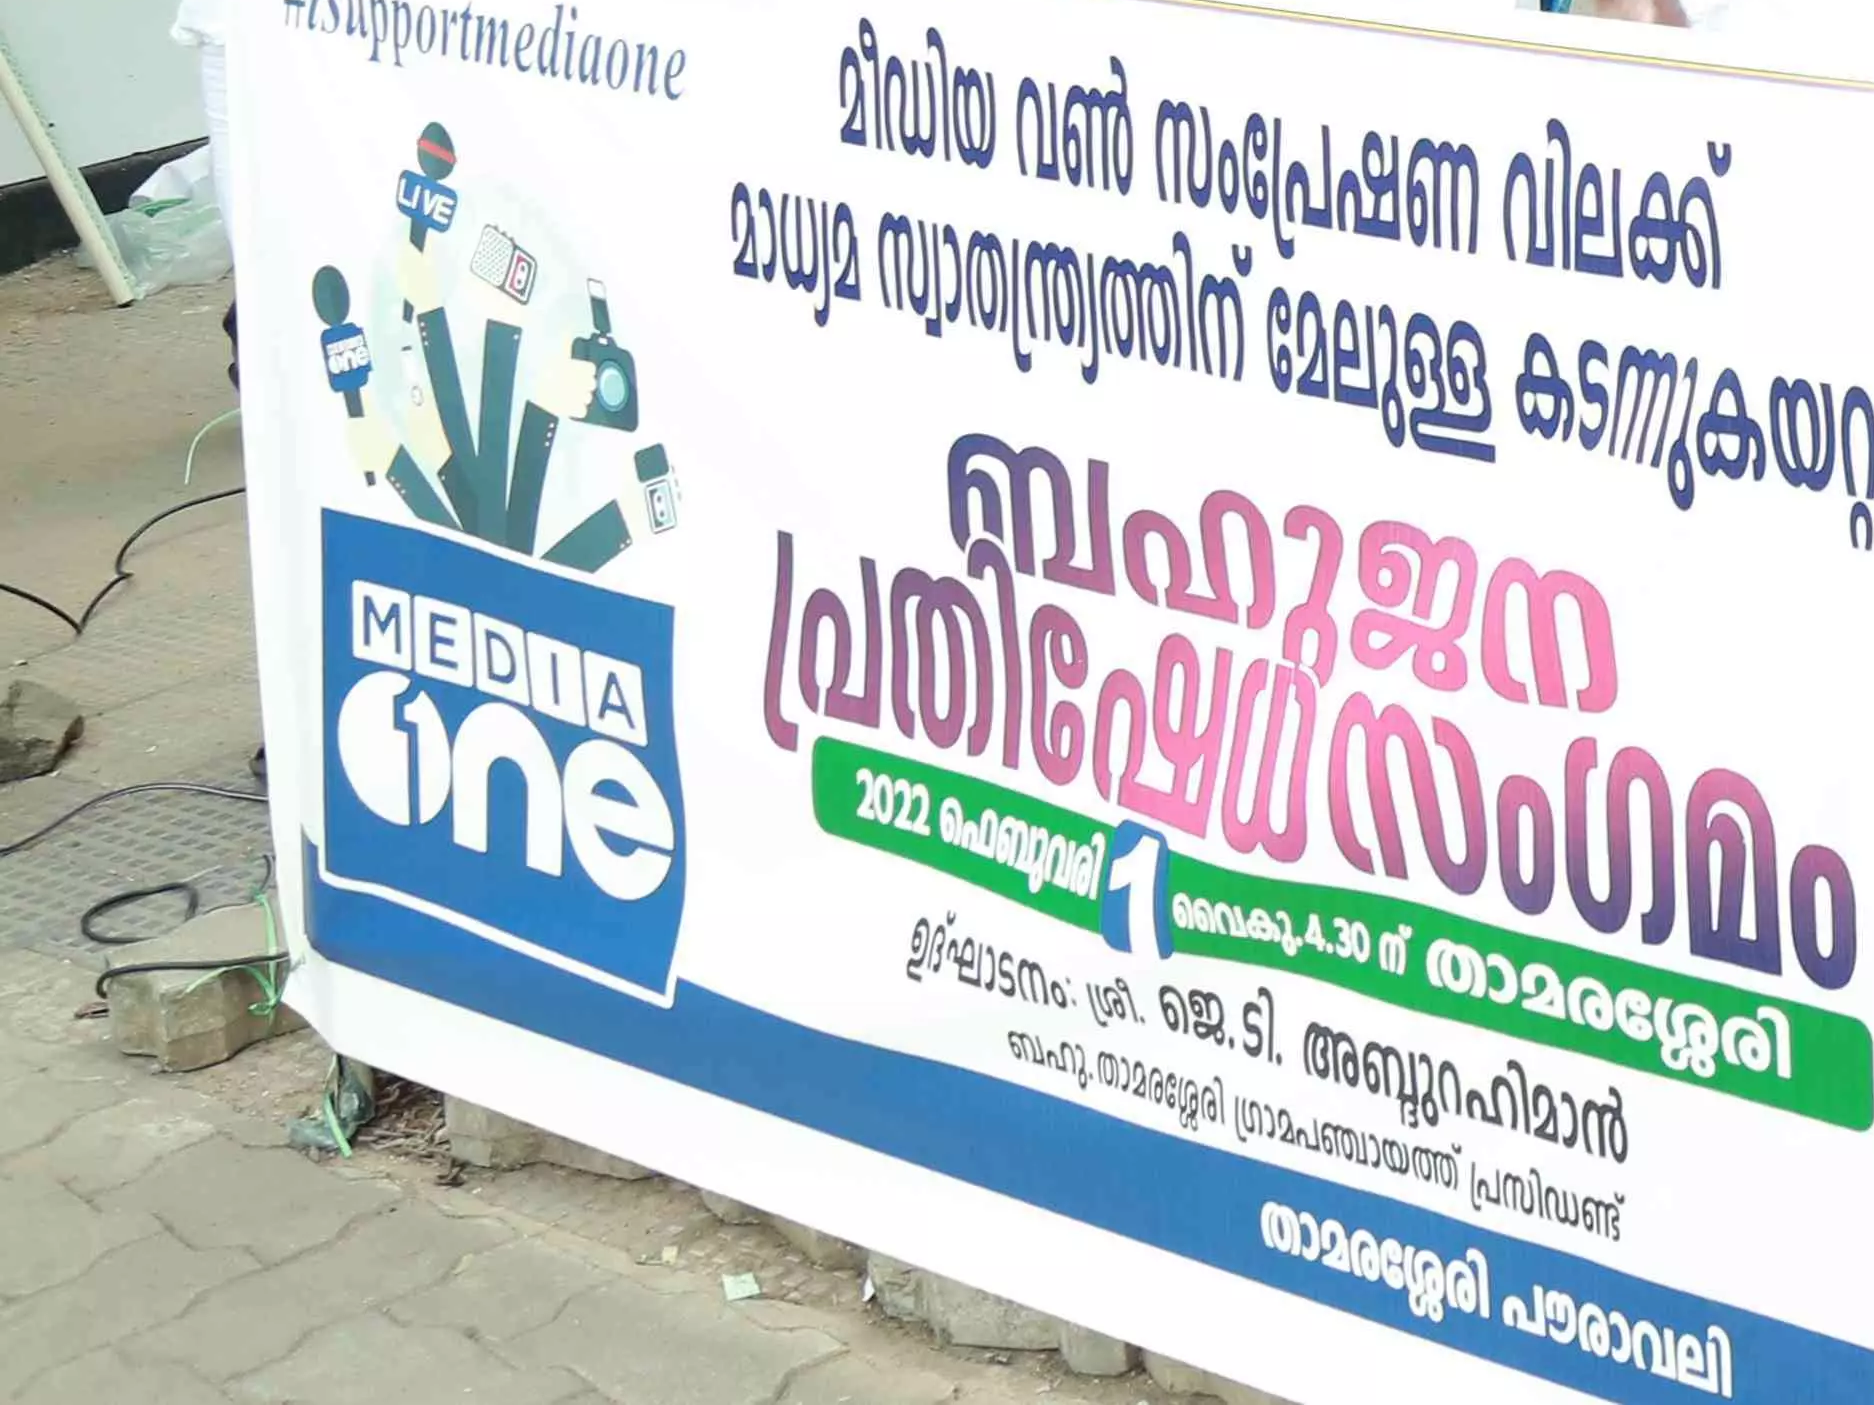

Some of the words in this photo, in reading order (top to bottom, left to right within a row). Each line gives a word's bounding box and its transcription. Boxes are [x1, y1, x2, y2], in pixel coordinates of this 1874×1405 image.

[398, 177, 456, 225] LIVE
[839, 16, 997, 170] മീഡിയ
[1015, 54, 1134, 197] വൺ
[1154, 94, 1480, 260] സംപ്രേഷണ
[1504, 118, 1733, 290] വിലക്ക്
[730, 181, 862, 327] മാധ്യമ
[1265, 286, 1496, 464] മേലുള്ള
[361, 591, 637, 732] MEDIA
[947, 433, 1619, 714] ബഹുജന
[763, 529, 1858, 991] പ്രതിഷേധസംഗമം
[855, 768, 931, 837] 2022
[1107, 834, 1163, 959] 1
[1425, 938, 1793, 1079] താമരശ്ശേരി
[1234, 1094, 1463, 1191] ഗ്രാമപഞ്ചായത്ത്
[1302, 1020, 1629, 1165] അബ്ദുറഹിമാൻ
[1259, 1199, 1493, 1324] താമരശ്ശേരി
[1501, 1283, 1735, 1399] പൗരാവലി
